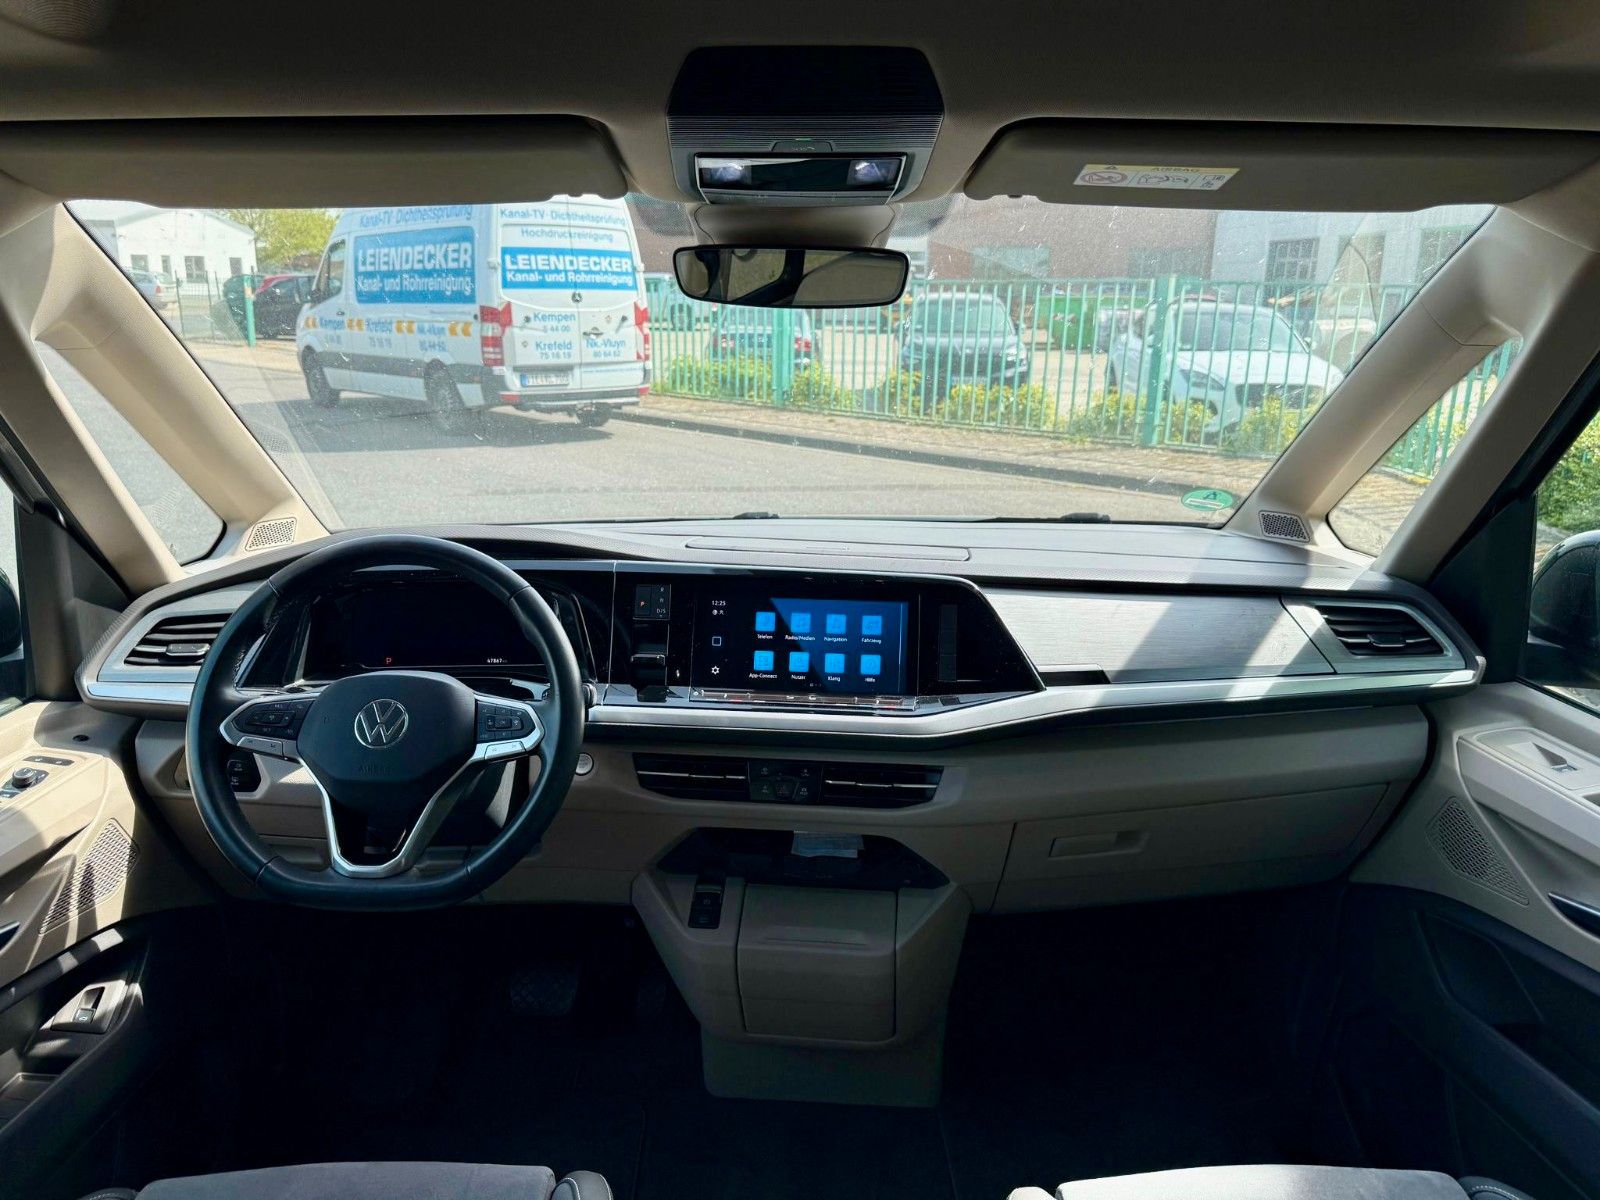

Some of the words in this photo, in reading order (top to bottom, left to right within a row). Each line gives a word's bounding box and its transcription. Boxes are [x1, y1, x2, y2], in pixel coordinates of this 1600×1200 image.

[500, 208, 545, 219] Kanal-TV
[550, 210, 627, 226] Dichtheitsprüfung
[520, 228, 614, 242] Hochdruckreinigung
[358, 242, 473, 272] LEIENDECKER
[504, 254, 633, 273] LEIENDECKER
[357, 276, 383, 293] Kanal-
[384, 276, 401, 292] und
[402, 273, 473, 296] Rohrreinigung
[506, 271, 543, 282] Kanal-
[545, 273, 566, 282] und
[567, 272, 634, 287] Rohrreinigung
[533, 312, 577, 324] Kempen
[535, 340, 573, 351] Krefeld
[586, 338, 626, 349] Nk.-Vluyn
[748, 672, 778, 680] App-Connect
